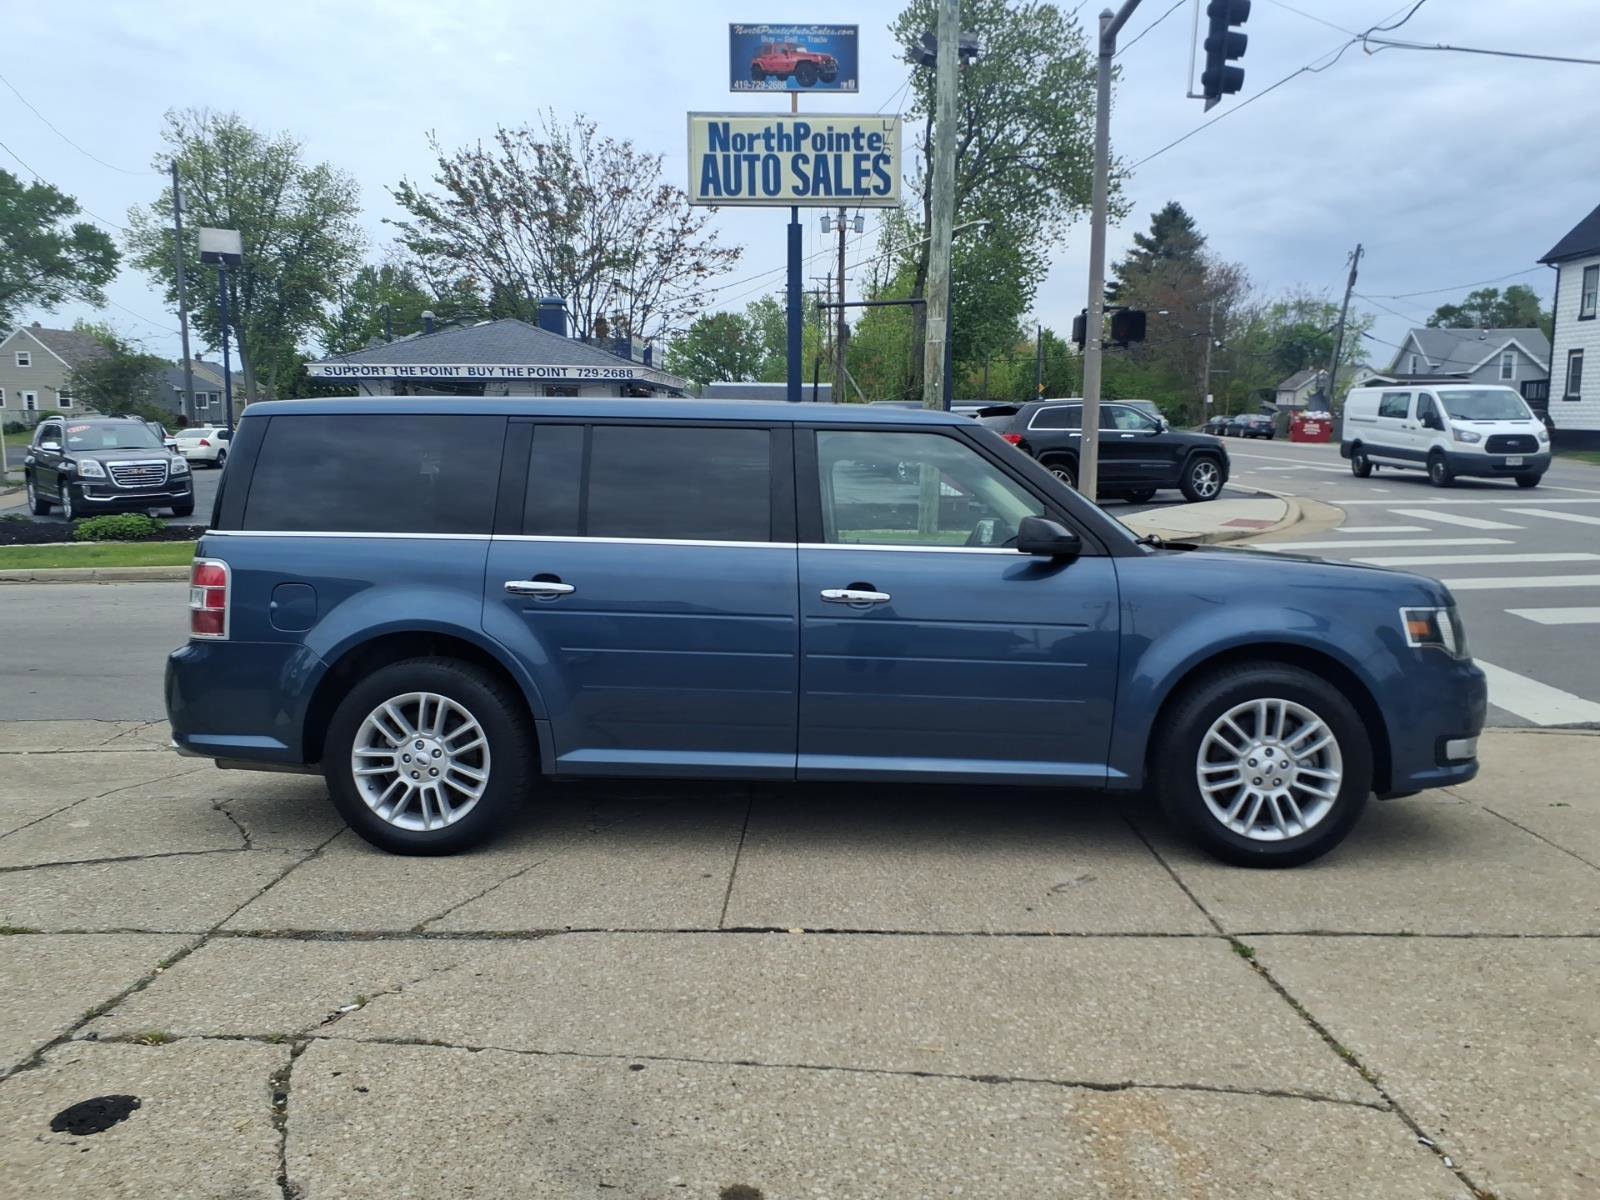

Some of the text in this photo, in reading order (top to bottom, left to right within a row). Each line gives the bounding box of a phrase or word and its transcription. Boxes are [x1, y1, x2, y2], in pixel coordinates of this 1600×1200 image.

[707, 122, 883, 152] NorthPointe
[700, 153, 892, 196] AUTO SALES
[324, 366, 633, 378] SUPPORT THE POINT BUY THE POINT 729-2688
